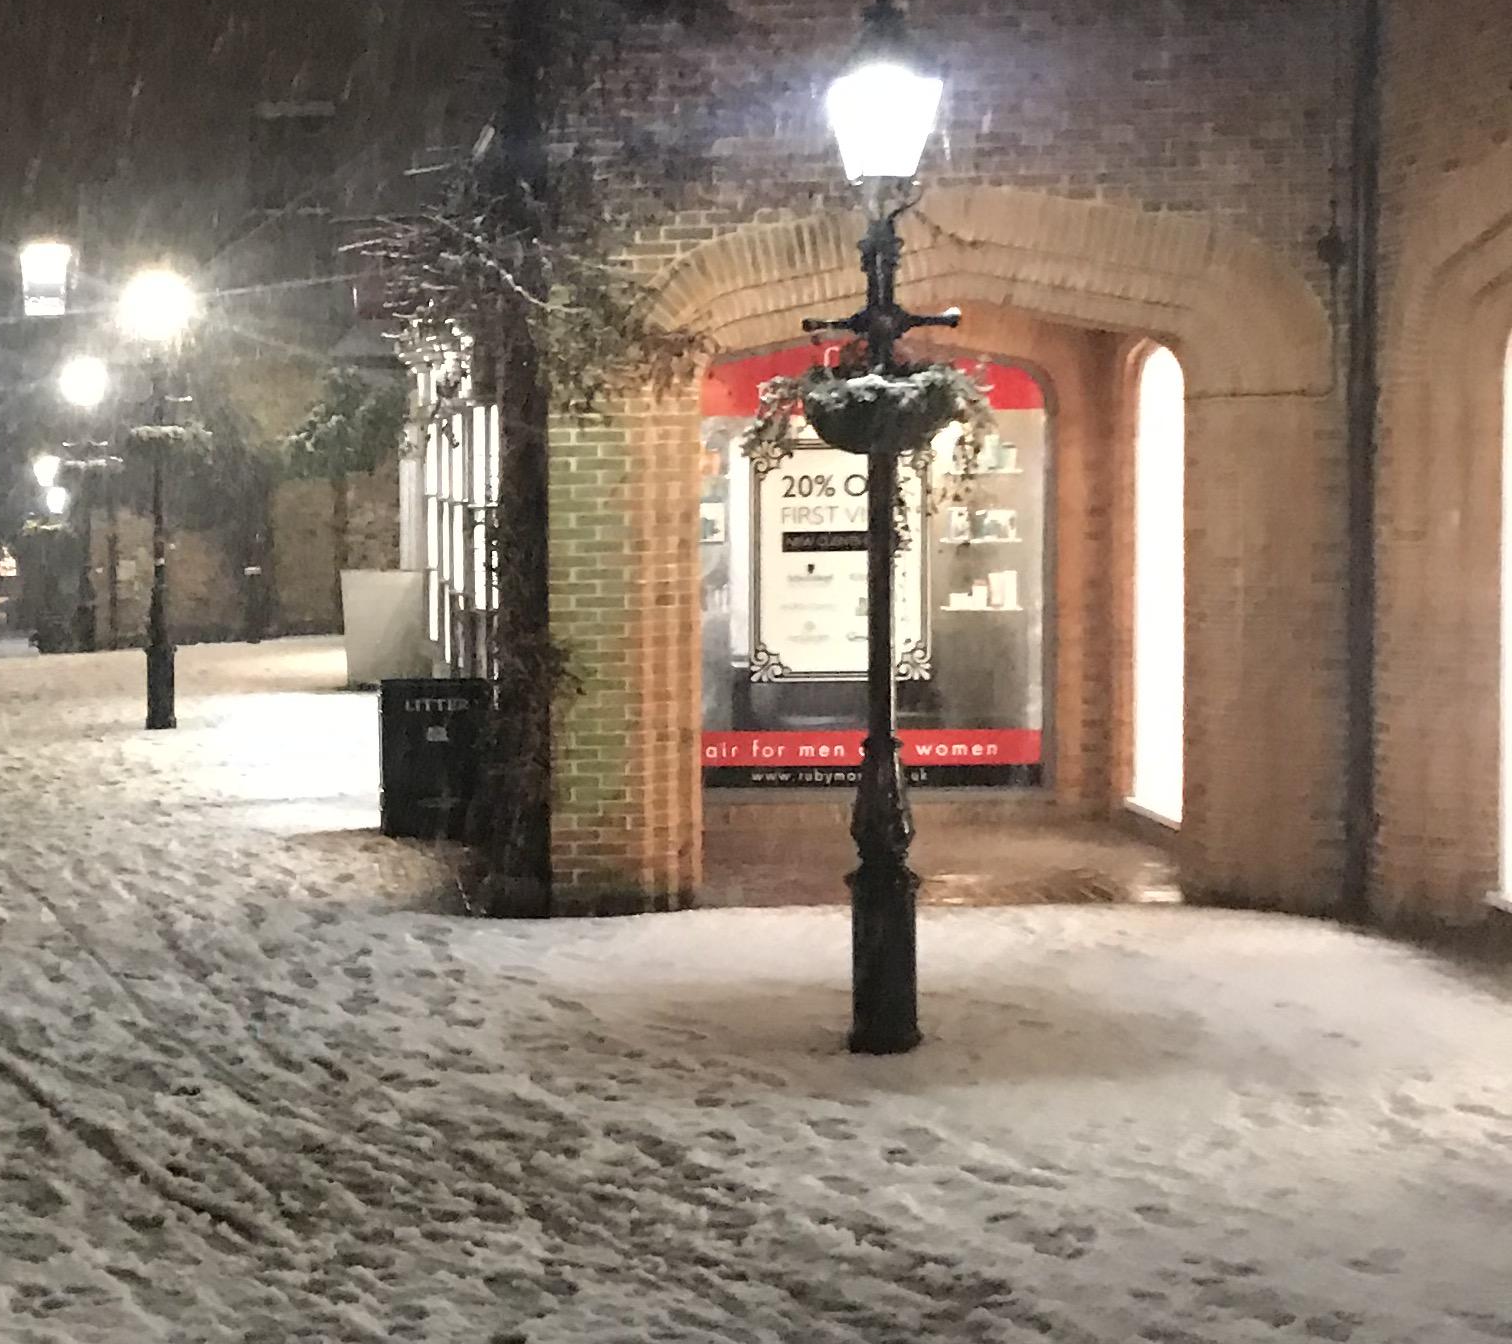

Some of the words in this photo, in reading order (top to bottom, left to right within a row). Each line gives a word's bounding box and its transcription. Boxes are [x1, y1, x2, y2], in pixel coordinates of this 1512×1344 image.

[782, 474, 836, 498] 20%
[782, 506, 839, 525] FIRST
[405, 698, 469, 712] LITTER
[705, 742, 738, 758] air
[752, 739, 786, 758] for
[799, 744, 845, 758] men
[915, 743, 998, 756] women
